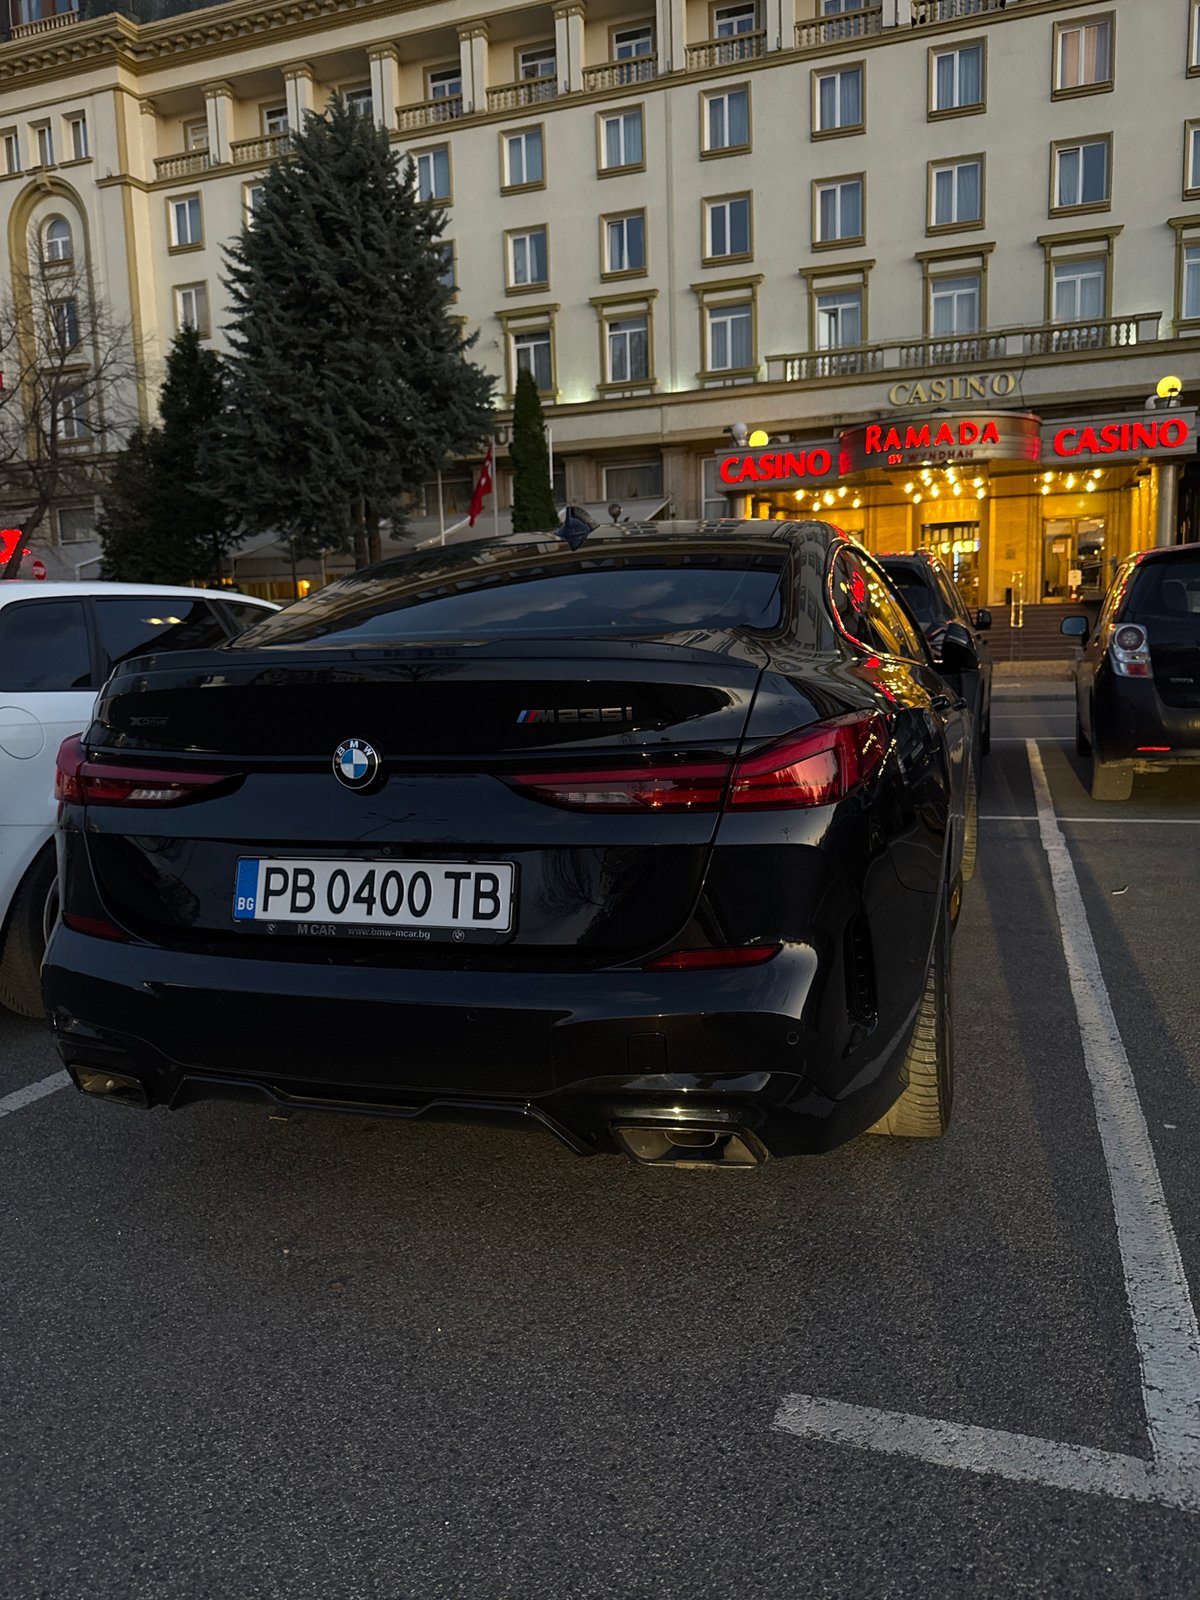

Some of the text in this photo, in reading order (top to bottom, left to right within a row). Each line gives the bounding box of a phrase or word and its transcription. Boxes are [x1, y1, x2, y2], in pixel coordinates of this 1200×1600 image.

[889, 372, 1016, 406] CASINO
[865, 420, 1000, 454] RAMADA
[1053, 418, 1188, 457] CASINO
[720, 448, 832, 483] CASINO
[336, 740, 373, 756] BMW
[237, 897, 255, 912] BG
[262, 867, 502, 921] PB 0400 TB
[348, 926, 431, 940] www.bmw-mcar.bg
